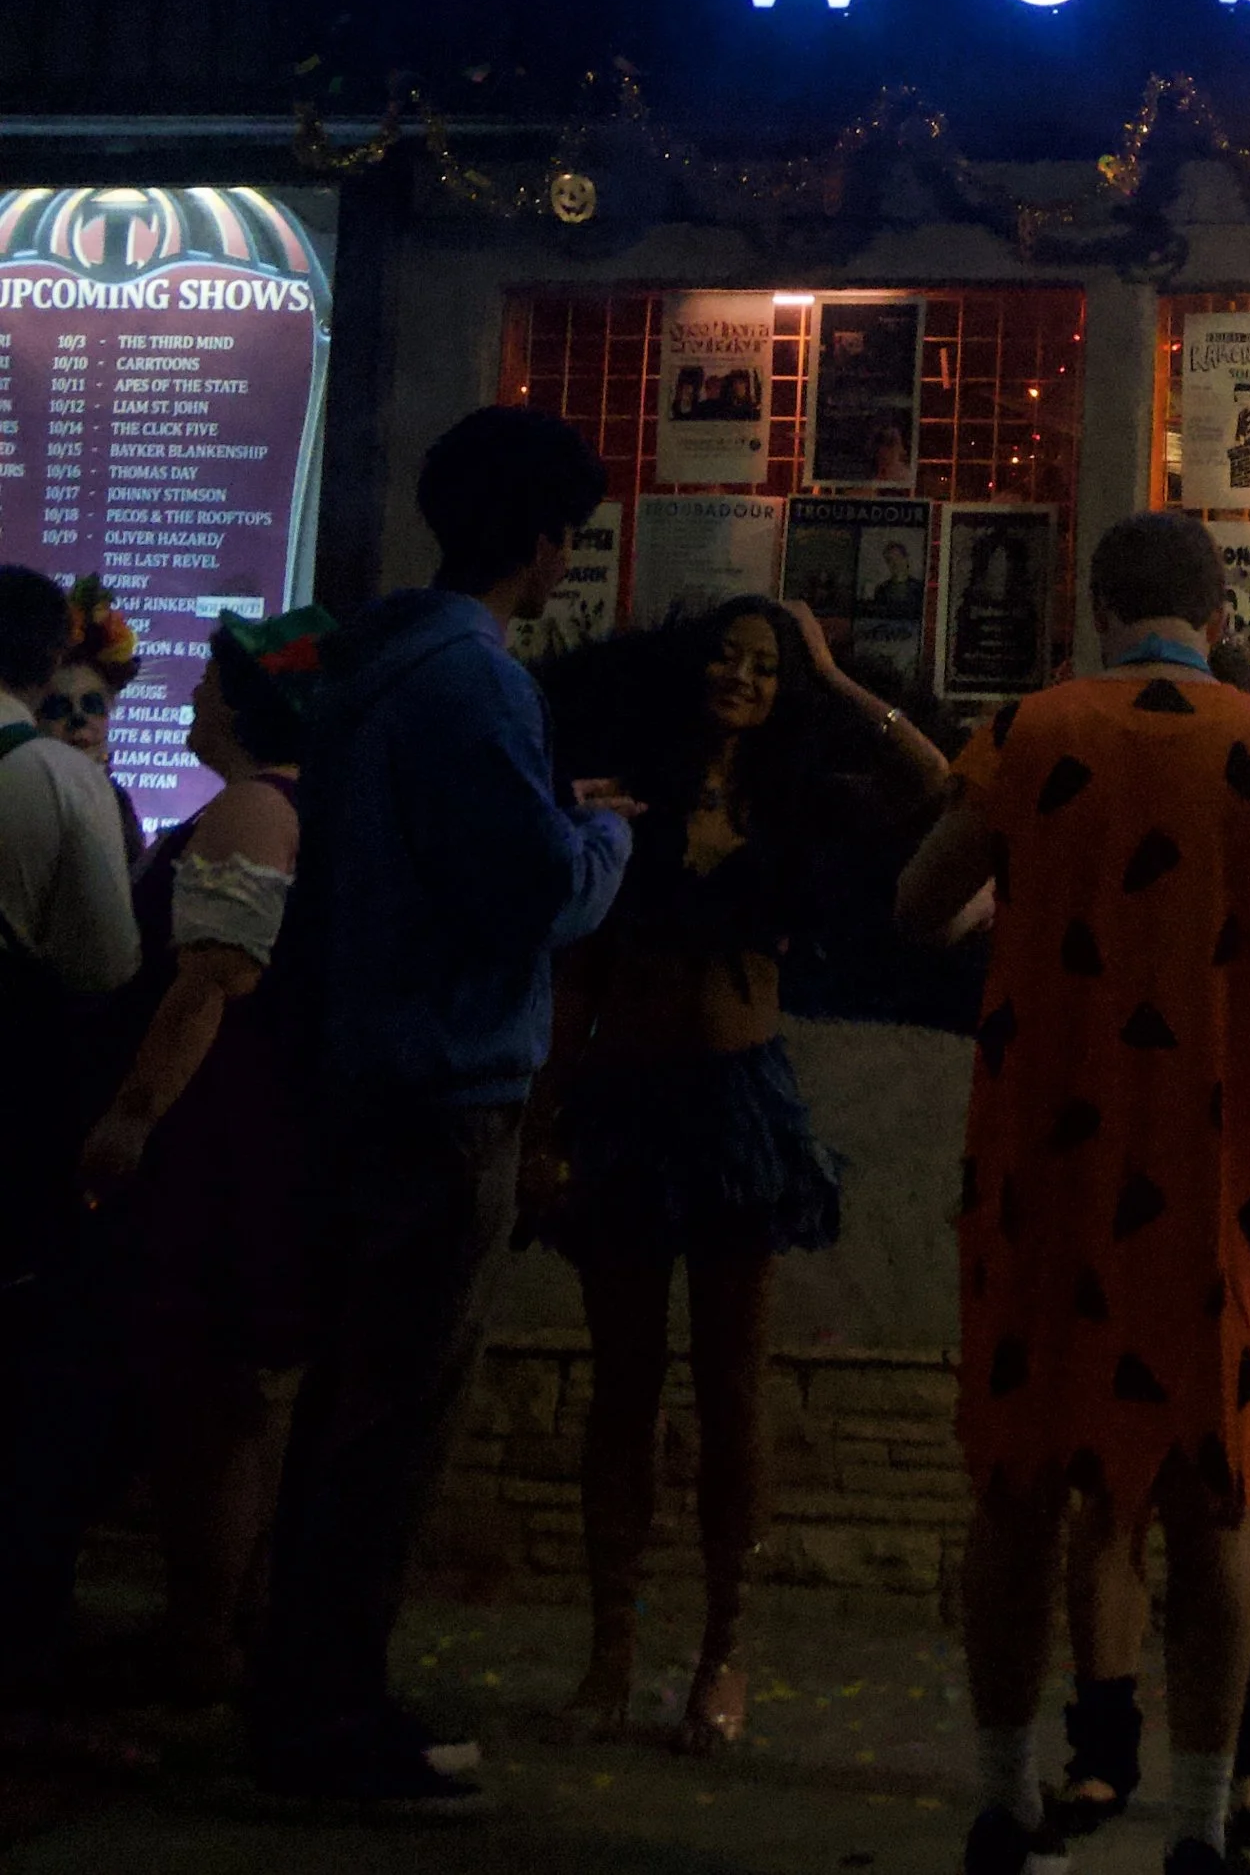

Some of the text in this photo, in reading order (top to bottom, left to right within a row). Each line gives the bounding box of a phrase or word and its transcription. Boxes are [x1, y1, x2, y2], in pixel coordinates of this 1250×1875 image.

[118, 335, 147, 350] THE
[149, 335, 194, 350] THIRD
[196, 336, 235, 350] MIND
[114, 379, 149, 393] APES
[151, 379, 170, 393] OF
[172, 379, 202, 393] THE
[204, 379, 249, 394] STATE
[112, 400, 149, 415] LIAM
[172, 401, 209, 416] JOHN
[111, 422, 140, 436] THE
[142, 422, 182, 437] CLICK
[185, 423, 220, 437] FIVE
[110, 443, 166, 458] BAYKER
[168, 444, 269, 460] BLANKENSHIP
[109, 466, 168, 480] THOMAS
[170, 466, 200, 481] DAY
[107, 487, 161, 503] JOHNNY
[163, 488, 228, 502] STIMSON
[106, 508, 148, 523] PECOS
[165, 509, 195, 523] THE
[197, 510, 273, 525] ROOFTOPS
[645, 501, 775, 520] TROUBADOUR
[795, 502, 925, 523] TROUBADOUR
[104, 530, 156, 546] OLIVER
[103, 552, 220, 568] THE LAST REVEL
[113, 750, 151, 765] LIAM
[139, 773, 178, 788] RYAN
